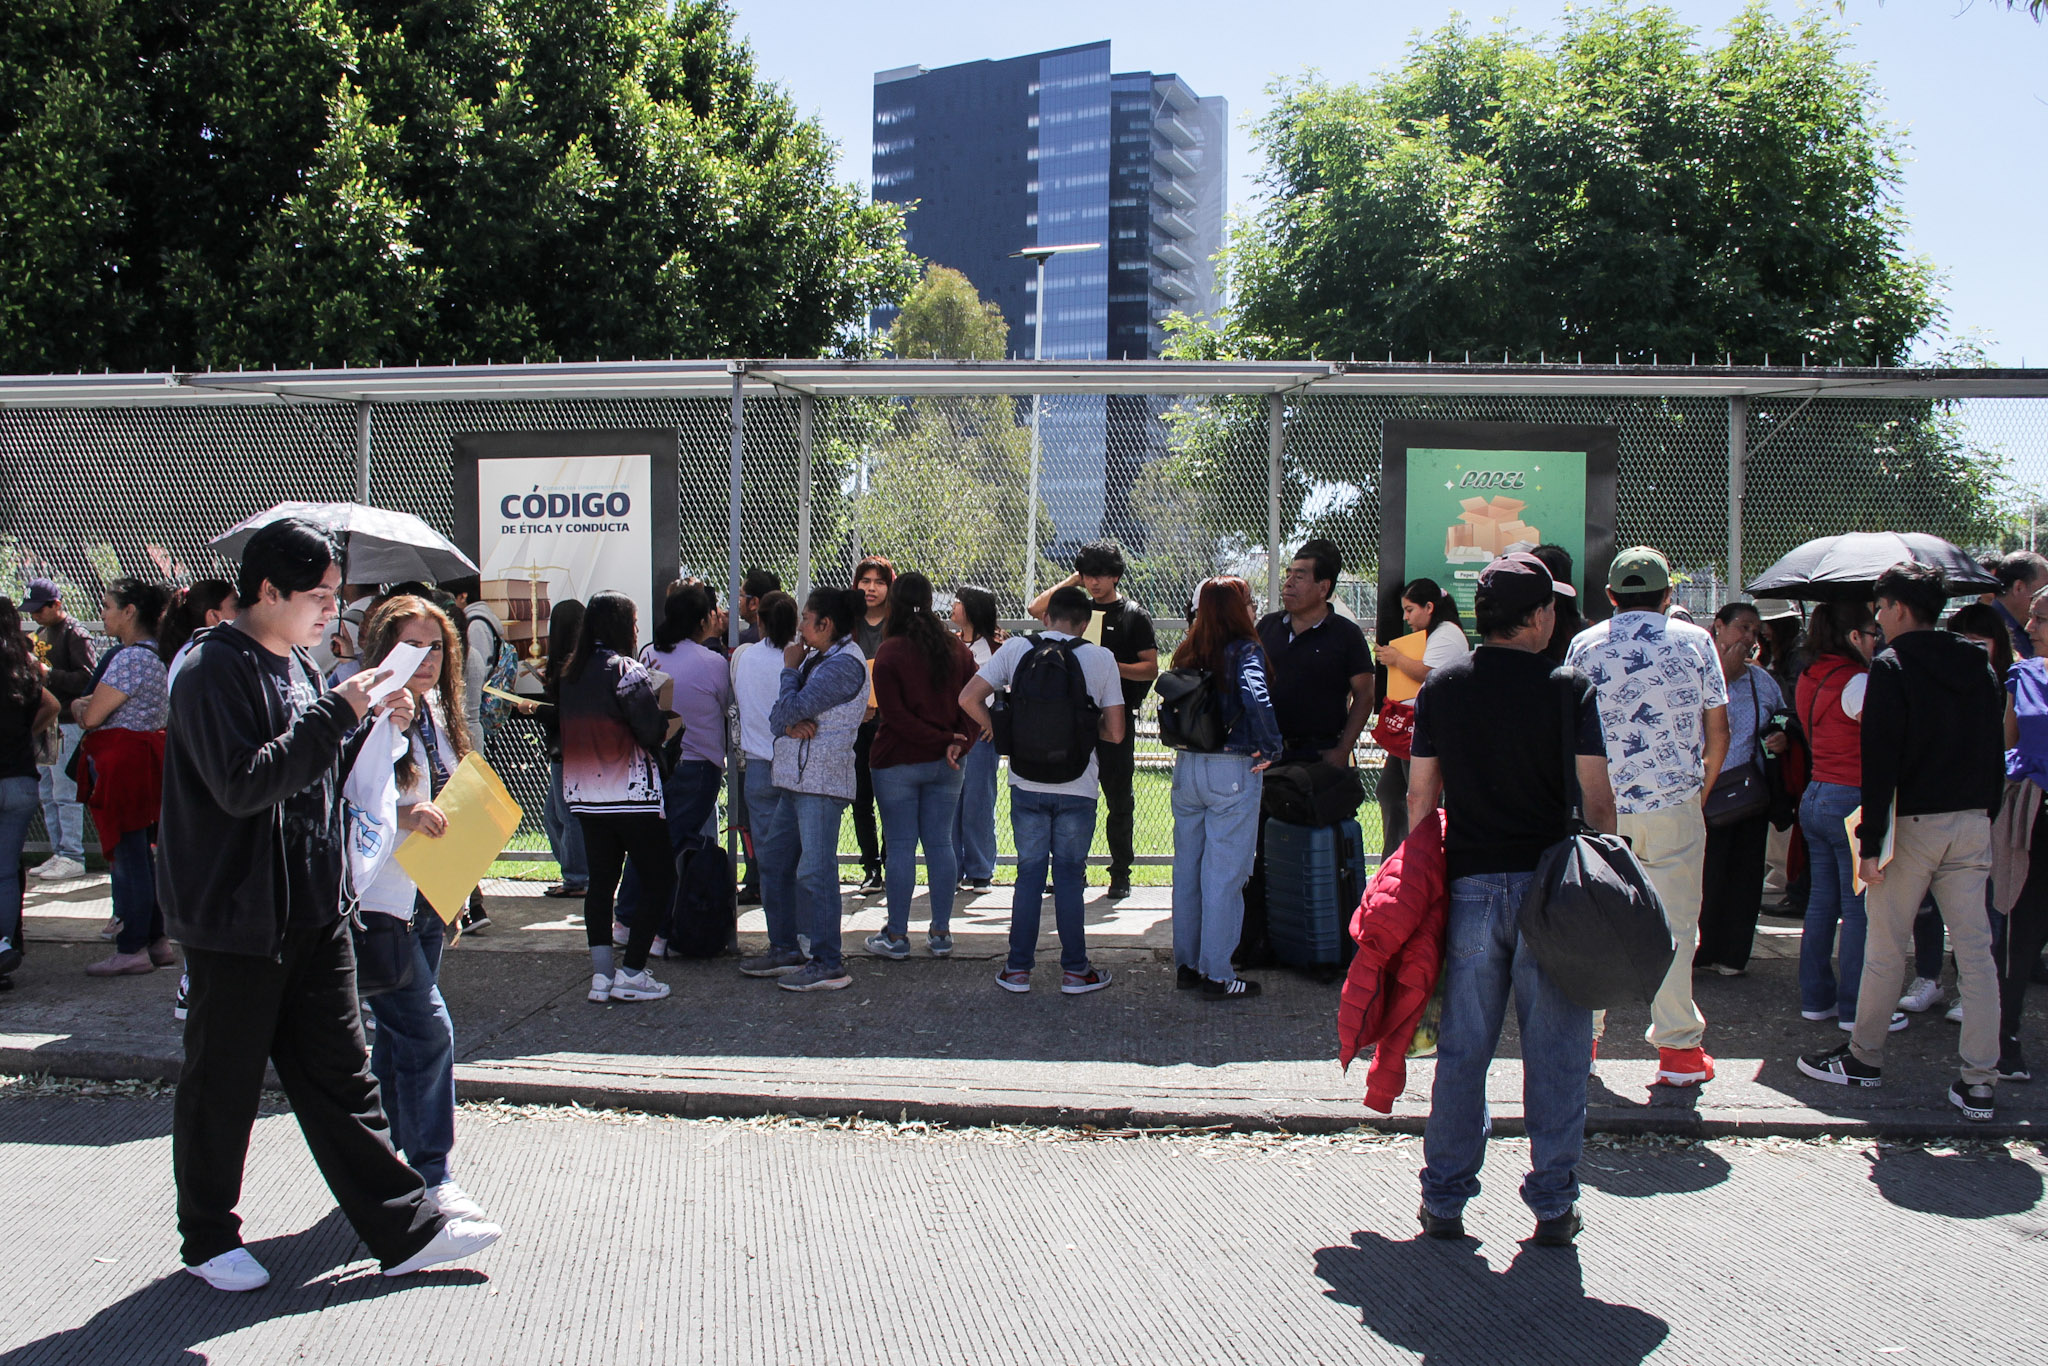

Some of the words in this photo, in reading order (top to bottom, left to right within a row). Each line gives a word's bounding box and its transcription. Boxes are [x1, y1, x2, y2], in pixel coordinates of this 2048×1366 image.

[1459, 470, 1525, 488] PAPEL
[500, 484, 631, 519] CÓDIGO
[501, 525, 516, 534] DE
[520, 522, 552, 534] ÉTICA
[555, 524, 563, 533] Y
[565, 523, 630, 533] CONDUCTA
[1385, 717, 1396, 726] OTE
